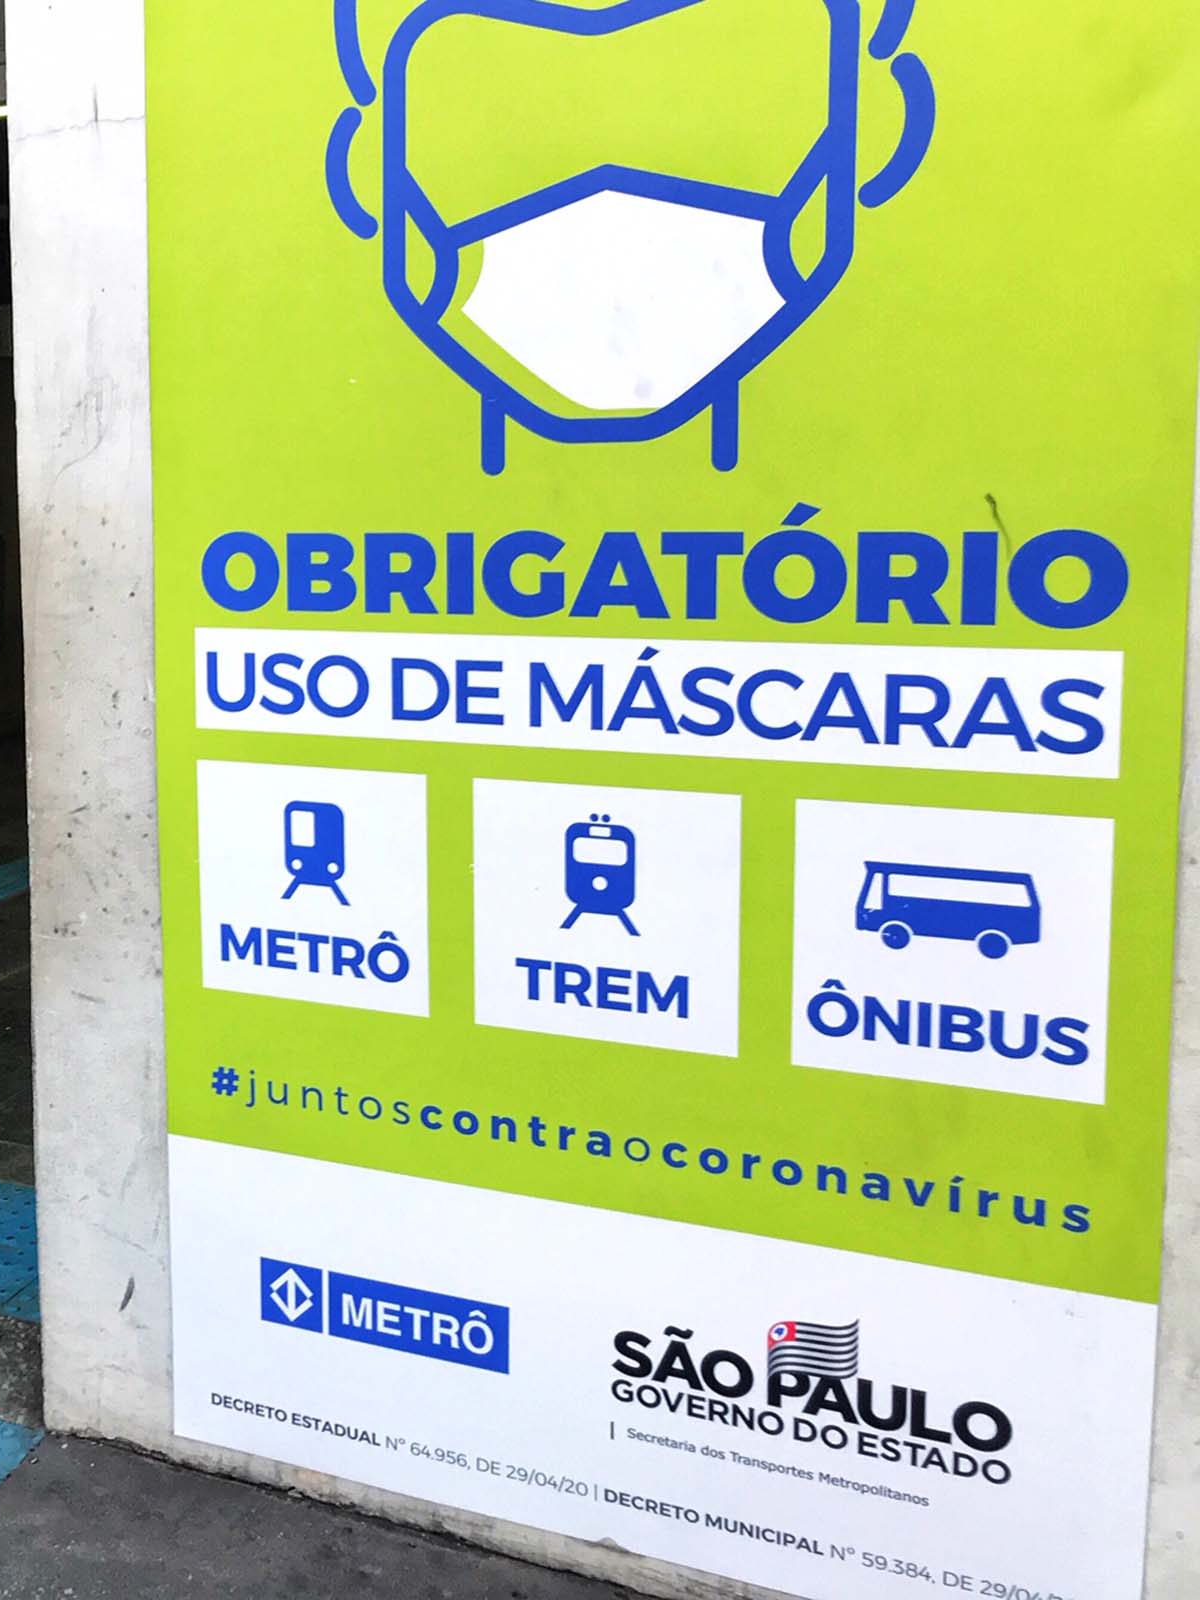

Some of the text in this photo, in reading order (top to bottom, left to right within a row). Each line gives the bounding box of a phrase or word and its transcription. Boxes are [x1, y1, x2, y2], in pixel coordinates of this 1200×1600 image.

[201, 503, 1129, 629] OBRIGATÓRIO
[206, 646, 1105, 755] USO DE MÁSCARAS
[219, 923, 410, 983] METRÔ
[515, 957, 690, 1019] TREM
[806, 978, 1090, 1067] ÔNIBUS
[211, 1066, 1092, 1233] #juntoscontraocoronavírus
[341, 1291, 496, 1356] METRÔ
[611, 1325, 1014, 1453] SÃO PAULO
[611, 1379, 1012, 1486] GOVERNO DO ESTADO
[210, 1392, 288, 1423] DECRETO
[291, 1412, 382, 1447] ESTADUAL
[409, 1441, 472, 1471] 64.956,
[475, 1457, 501, 1476] DE
[506, 1464, 589, 1497] 29/04/20
[603, 1487, 700, 1524] DECRETO
[704, 1512, 825, 1556] MUNICIPAL
[942, 1571, 974, 1592] DE
[627, 1427, 930, 1507] Secretaria dos Transportes Metropolitanos
